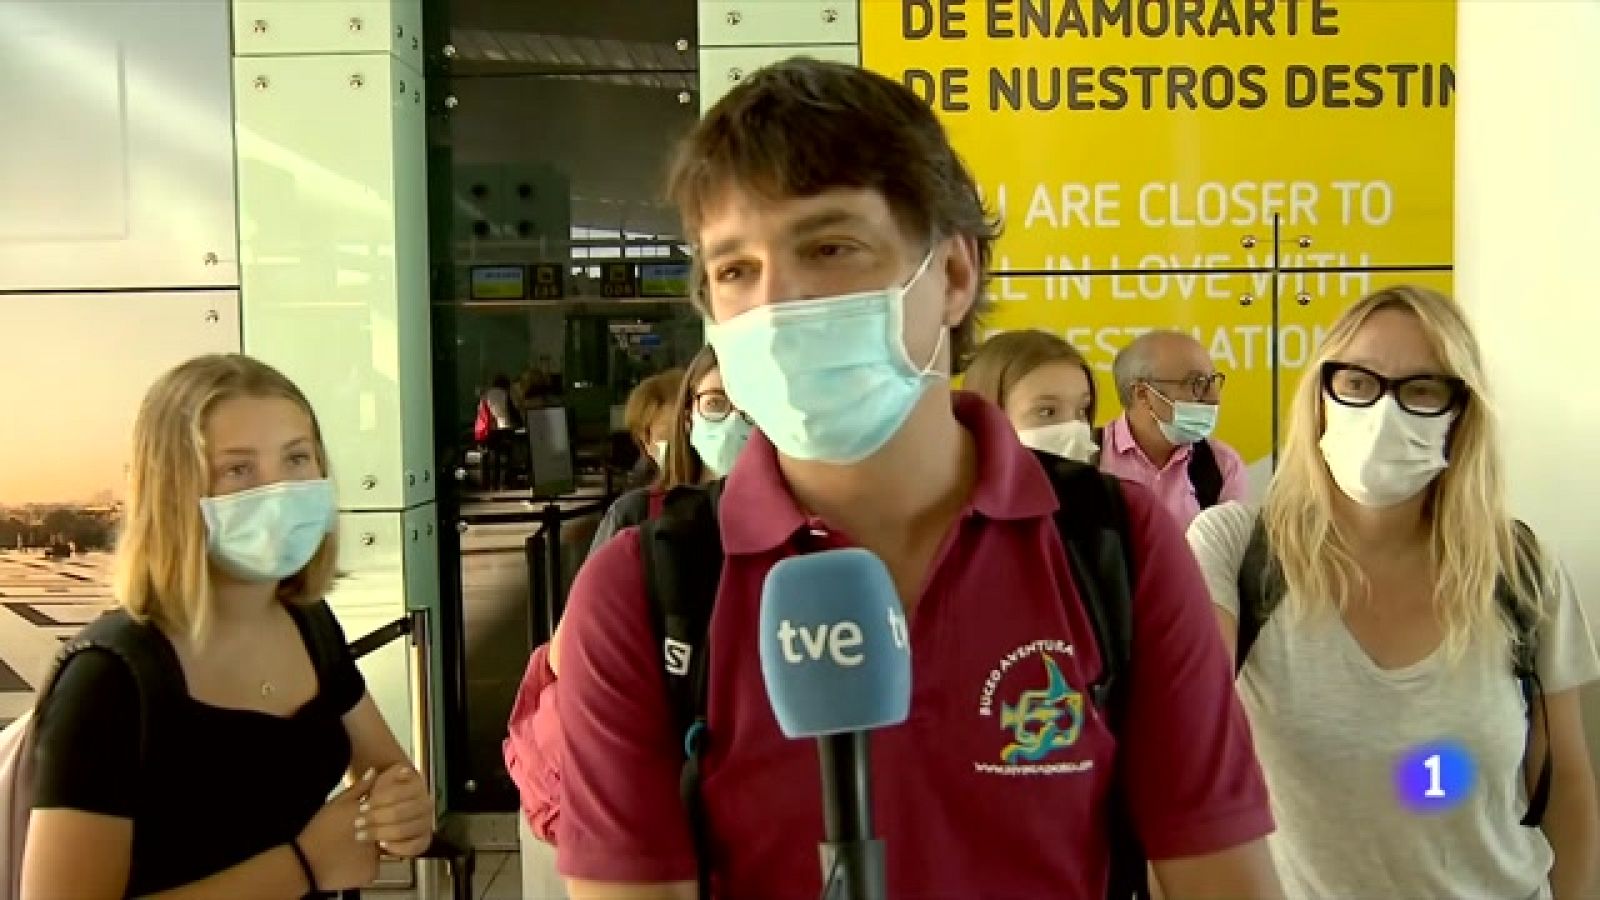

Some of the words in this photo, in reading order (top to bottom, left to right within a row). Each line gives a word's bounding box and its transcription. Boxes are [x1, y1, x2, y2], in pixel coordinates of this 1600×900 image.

[902, 0, 967, 40] DE
[986, 0, 1339, 39] ENAMORARTE
[904, 69, 968, 111] DE
[989, 66, 1266, 111] NUESTROS
[1025, 183, 1121, 228] ARE
[1139, 181, 1319, 227] CLOSER
[1332, 180, 1393, 226] TO
[1045, 255, 1091, 300] IN
[1112, 253, 1231, 300] LOVE
[1243, 252, 1371, 298] WITH
[777, 620, 864, 666] tve
